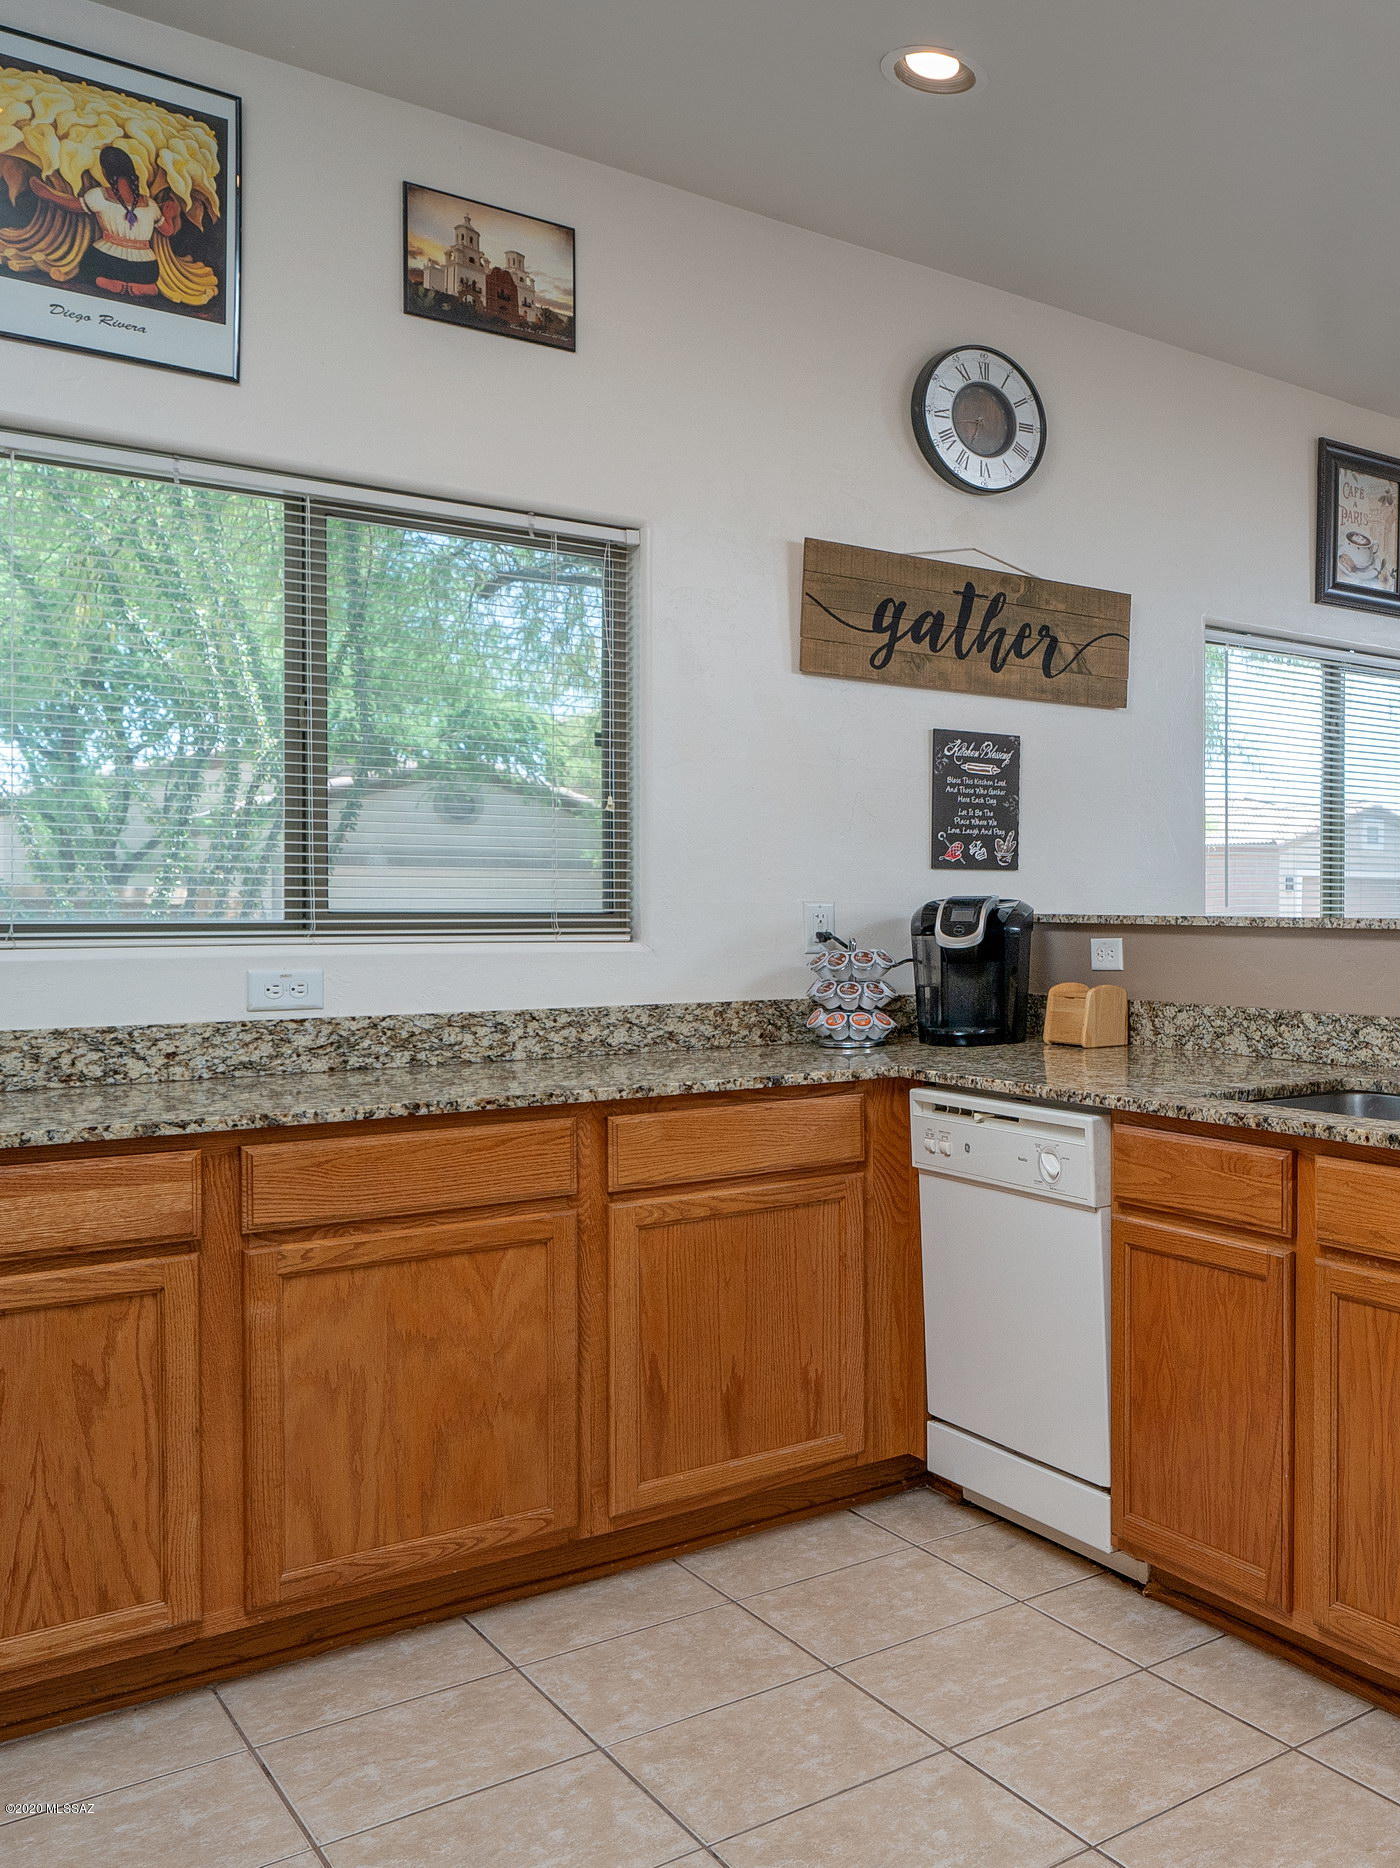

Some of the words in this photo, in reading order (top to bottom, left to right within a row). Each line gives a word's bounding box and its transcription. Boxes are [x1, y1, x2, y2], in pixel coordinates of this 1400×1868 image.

[49, 303, 92, 323] Diego
[98, 314, 147, 334] Rivera
[1339, 504, 1369, 527] PARIS
[869, 581, 1058, 678] gather
[944, 739, 979, 764] Kitchen
[980, 741, 1014, 767] Blessing
[946, 776, 961, 784] Bless
[962, 777, 973, 785] This
[974, 778, 993, 786] Kitchen
[945, 785, 958, 793] And
[959, 786, 974, 794] Those
[975, 787, 987, 795] Who
[988, 787, 1006, 796] Gather
[957, 795, 970, 803] Here
[971, 796, 984, 804] Each
[985, 797, 997, 807] Day
[968, 808, 974, 816] It
[983, 809, 993, 817] The
[953, 817, 970, 825] Place
[970, 817, 987, 826] Where
[962, 827, 979, 837] Laugh
